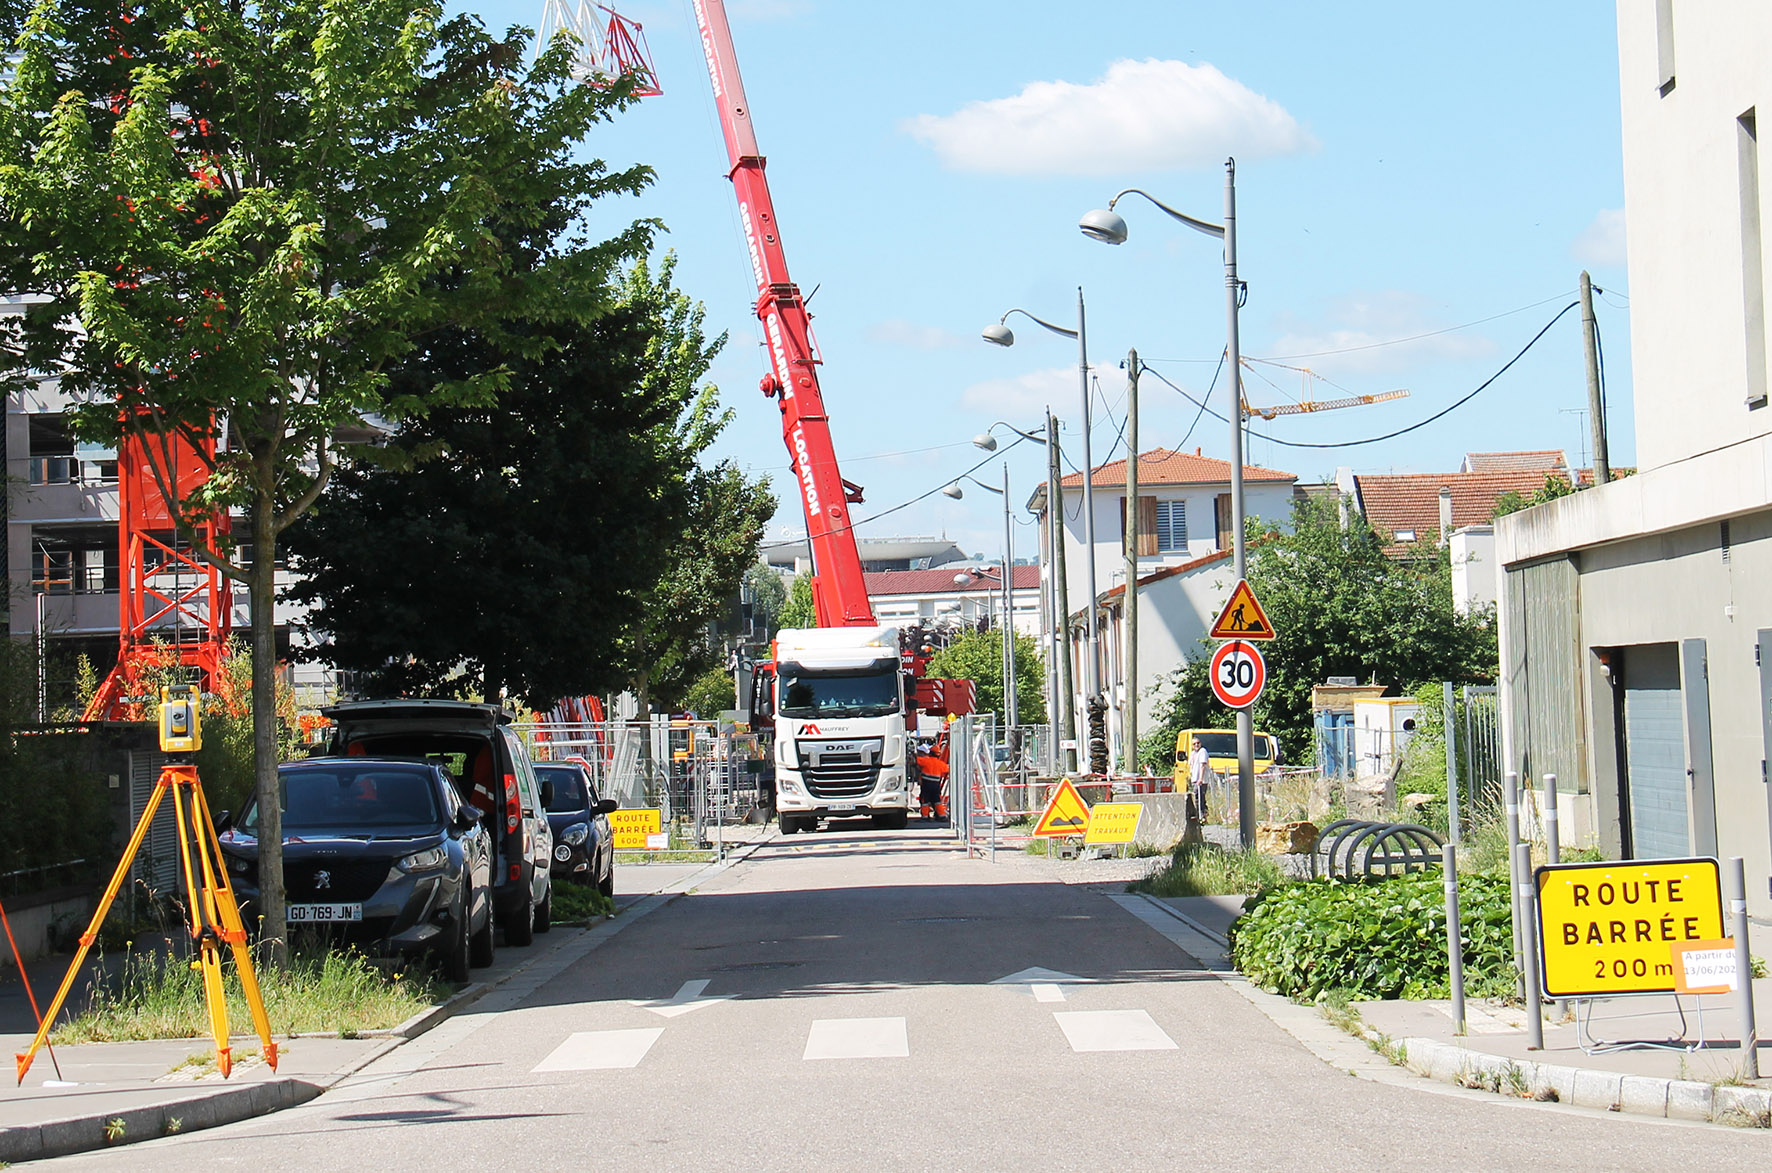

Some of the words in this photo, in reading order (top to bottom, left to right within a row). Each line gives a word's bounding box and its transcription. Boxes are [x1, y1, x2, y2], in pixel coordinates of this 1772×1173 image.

[701, 30, 722, 98] LOCATION
[740, 201, 765, 286] GERARDIN
[766, 313, 794, 400] GERARDIN
[793, 428, 820, 516] LOCATION
[1221, 660, 1253, 688] 30
[612, 824, 654, 834] BARRÉE
[616, 814, 650, 822] ROUTE
[1095, 812, 1136, 820] ATTENTION
[1573, 879, 1683, 907] ROUTE
[1562, 912, 1701, 946] BARRÉE
[1594, 958, 1647, 979] 200
[1655, 963, 1673, 976] m
[1696, 951, 1722, 961] partir
[1685, 965, 1737, 976] 13/06/202
